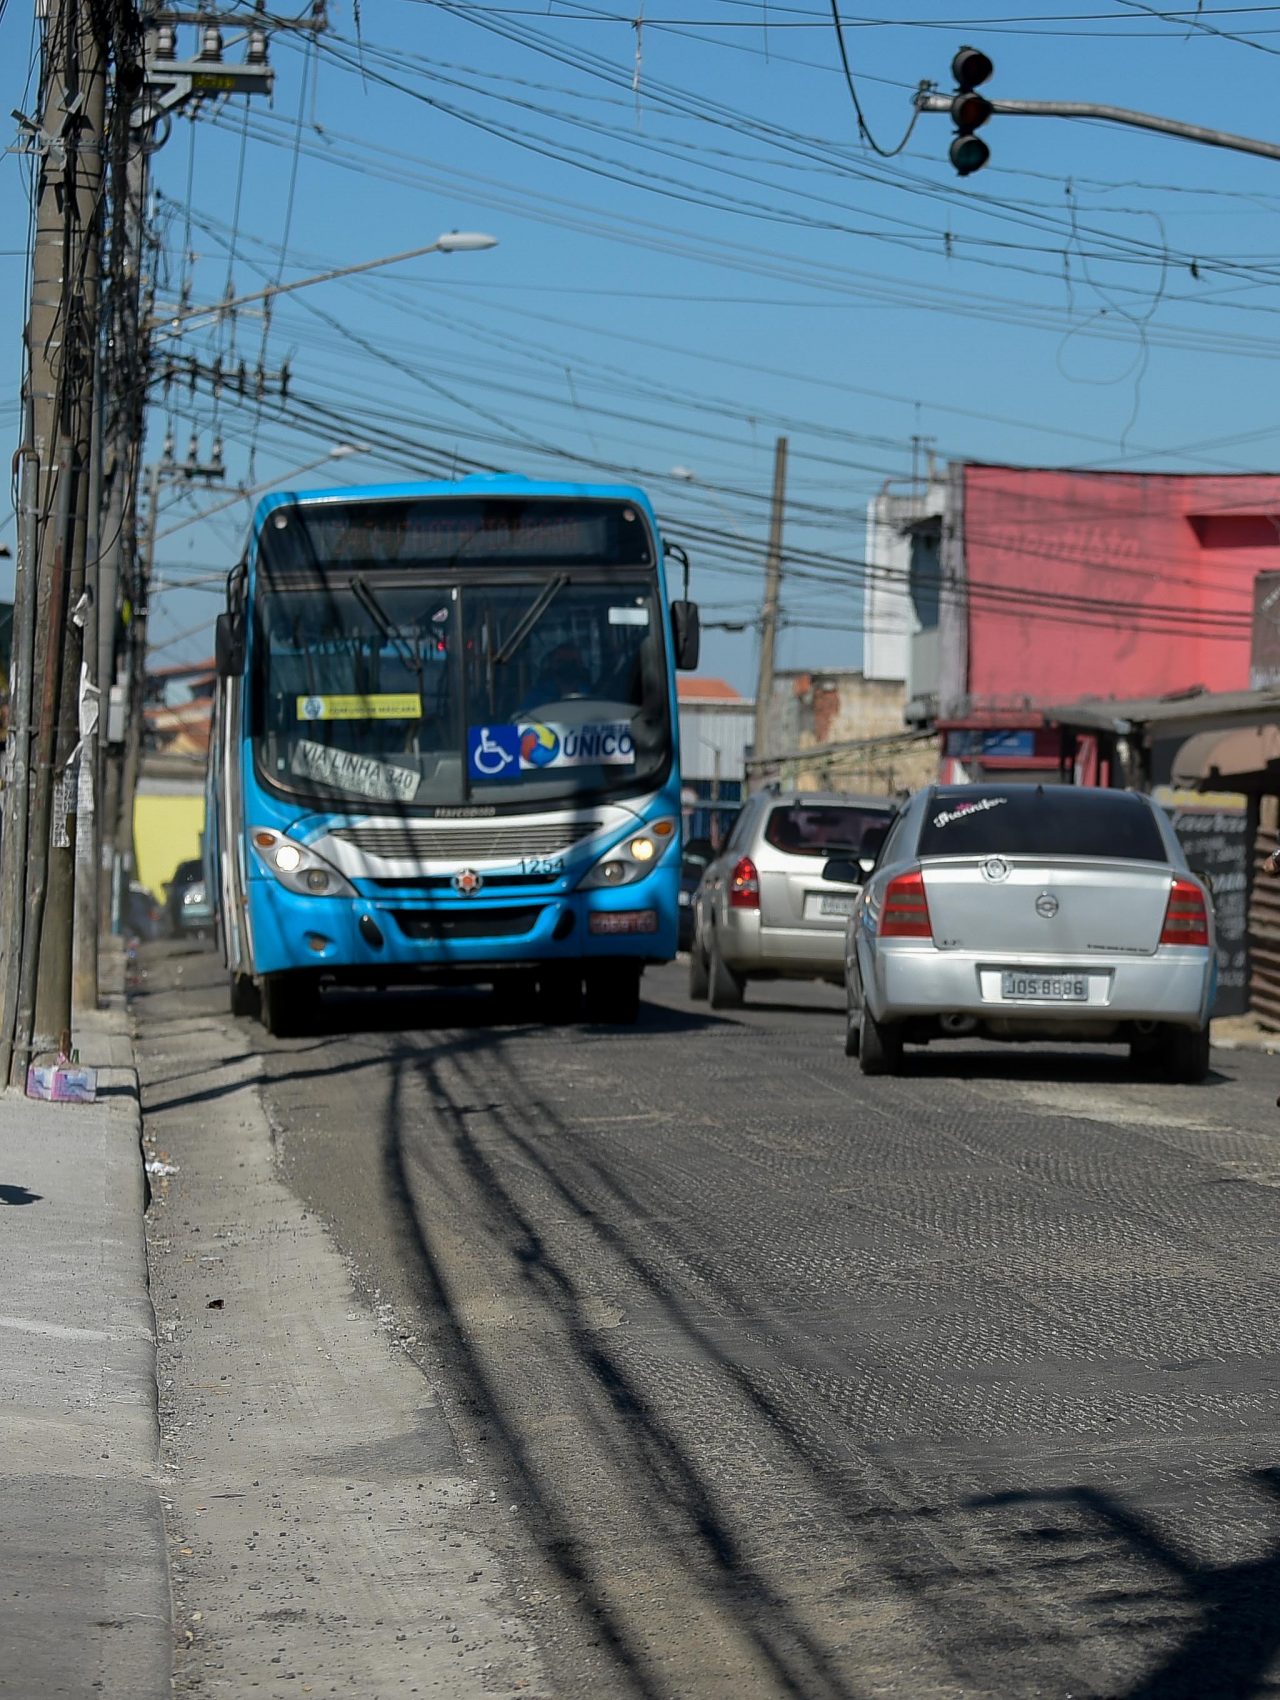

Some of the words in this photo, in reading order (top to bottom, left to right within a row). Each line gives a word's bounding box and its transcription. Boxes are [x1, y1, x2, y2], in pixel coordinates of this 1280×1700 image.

[563, 730, 636, 757] ÚNICO
[302, 743, 329, 767] VIA
[331, 750, 382, 782] LINHA
[384, 767, 413, 790] 340
[517, 857, 565, 875] 1254
